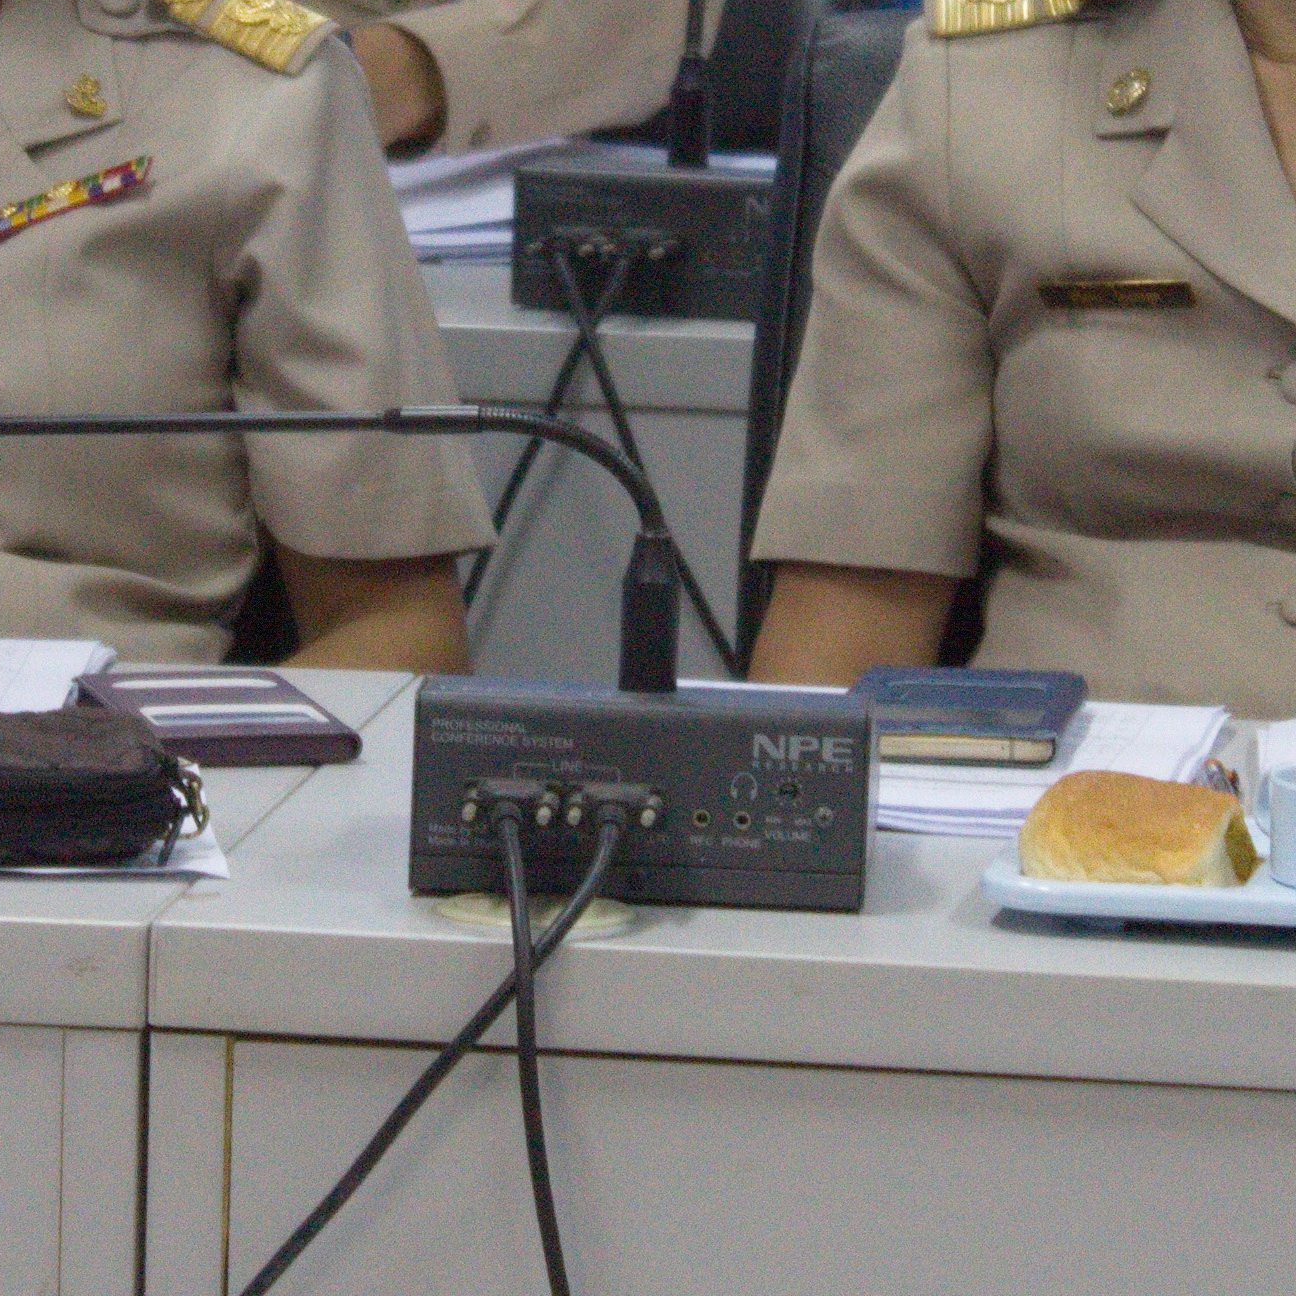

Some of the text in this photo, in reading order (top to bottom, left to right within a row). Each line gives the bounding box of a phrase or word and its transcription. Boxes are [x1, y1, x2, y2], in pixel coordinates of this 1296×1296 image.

[431, 718, 526, 734] PROFESSIONAL
[431, 732, 574, 749] CONFERENCE SYSTEM
[753, 733, 854, 763] NPE
[764, 830, 811, 842] VOLUME
